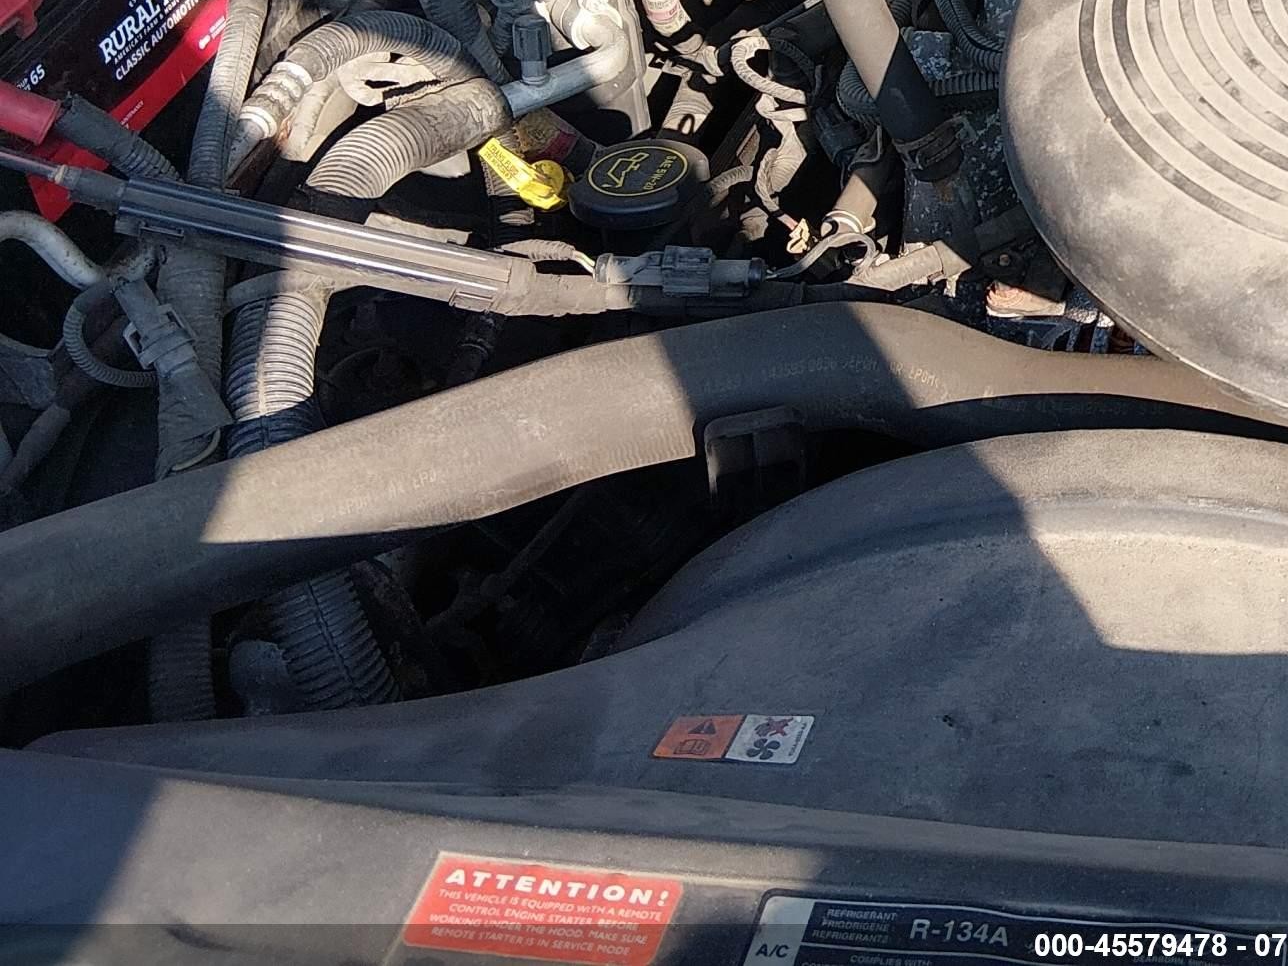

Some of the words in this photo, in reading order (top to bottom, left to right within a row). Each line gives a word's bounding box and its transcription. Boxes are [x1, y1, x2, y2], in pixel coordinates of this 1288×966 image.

[114, 32, 143, 64] AMERICA'S
[143, 19, 159, 35] FARM
[30, 64, 45, 85] 65
[115, 40, 151, 81] CLASSIC
[659, 155, 678, 169] SAE
[642, 168, 668, 190] 5W-20
[445, 869, 669, 907] ATTENTION!
[439, 888, 461, 900] THIS
[464, 892, 508, 905] VEHICLE
[510, 896, 519, 905] IS
[521, 898, 574, 913] EQUIPPED
[576, 905, 605, 914] WITH
[608, 907, 616, 915] A
[618, 908, 662, 922] REMOTE
[448, 903, 500, 916] CONTROL
[504, 908, 546, 922] ENGINE
[597, 918, 639, 931] BEFORE
[429, 914, 481, 927] WORKING
[484, 920, 522, 931] UNDER
[526, 925, 546, 934] THE
[588, 930, 618, 941] MAKE
[621, 934, 648, 945] SURE
[432, 927, 476, 940] REMOTE
[478, 931, 524, 944] STARTER
[526, 937, 535, 945] IS
[537, 938, 550, 948] IN
[552, 940, 594, 952] SERVICE
[597, 944, 630, 955] MODE
[909, 918, 1008, 947] R-134A
[756, 944, 790, 958] A/C
[850, 955, 901, 966] COMPLIES
